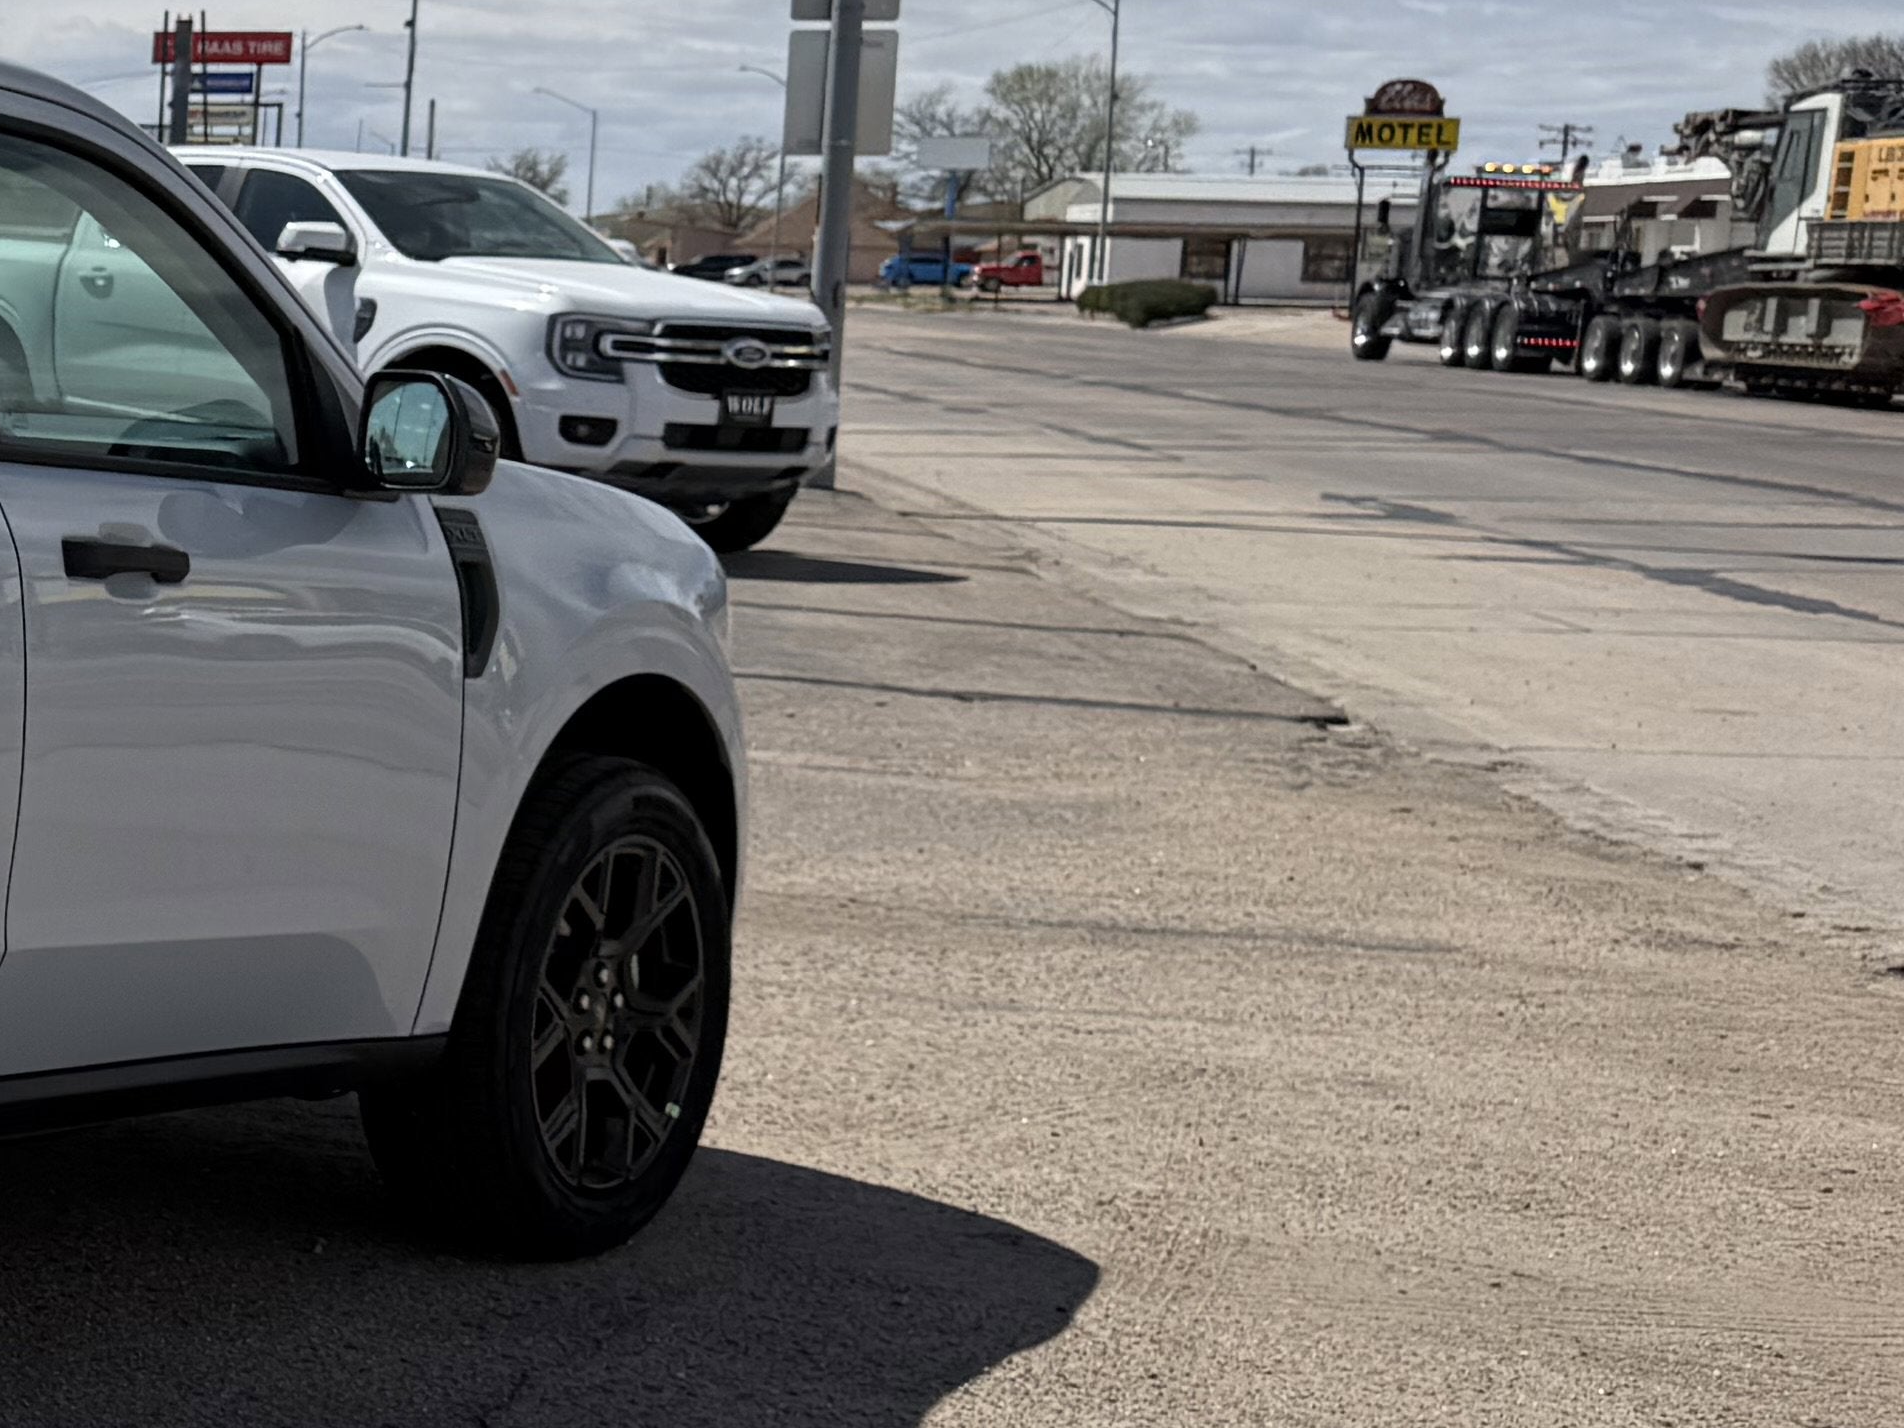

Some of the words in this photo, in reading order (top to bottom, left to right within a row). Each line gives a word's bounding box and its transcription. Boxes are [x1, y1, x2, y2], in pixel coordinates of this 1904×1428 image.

[247, 39, 286, 55] TIRE
[1354, 121, 1452, 147] MOTEL
[727, 395, 772, 415] WOLF
